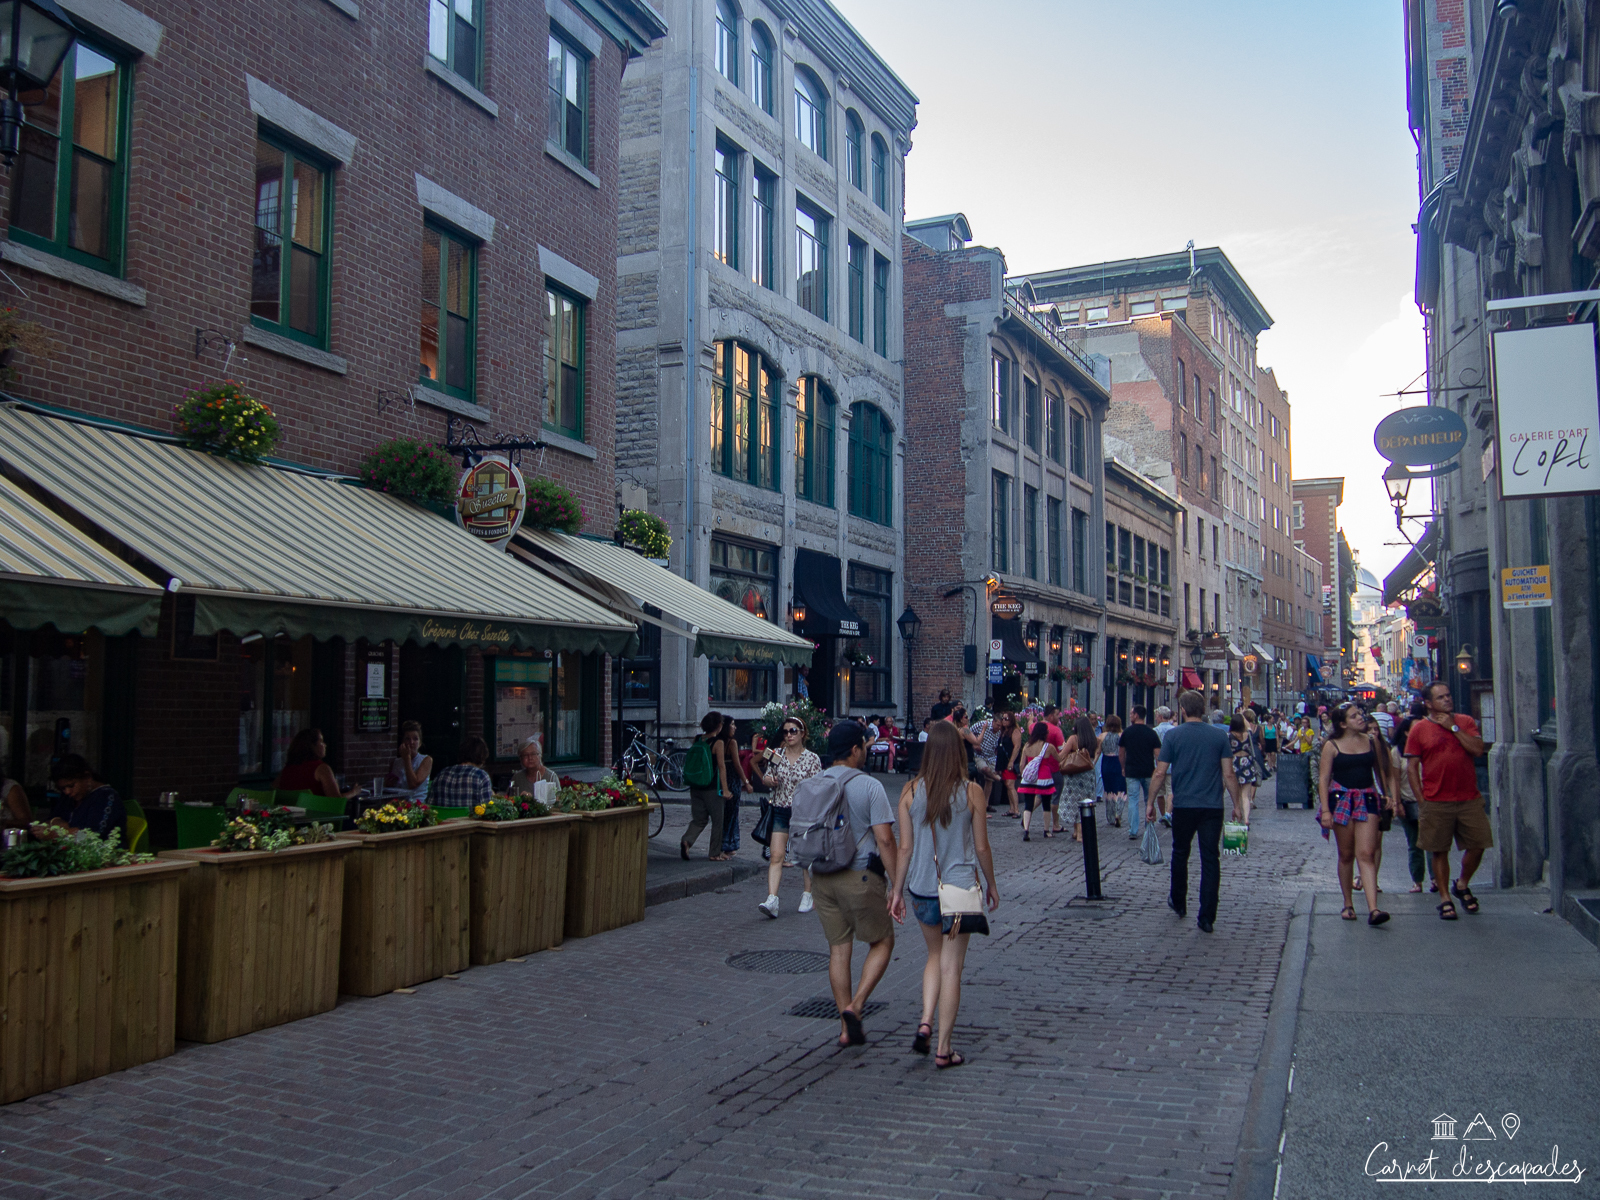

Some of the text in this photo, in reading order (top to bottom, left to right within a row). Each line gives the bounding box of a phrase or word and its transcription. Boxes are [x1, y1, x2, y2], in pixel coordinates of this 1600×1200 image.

[1509, 427, 1589, 443] GALERIE D'ART
[469, 492, 508, 514] Suzette
[488, 526, 508, 536] FONDUES
[1512, 568, 1537, 577] GUICHET
[1505, 576, 1547, 586] AUTOMATIQUE
[840, 620, 859, 630] THE KEG
[422, 618, 510, 643] Crêperie Chez Suzette
